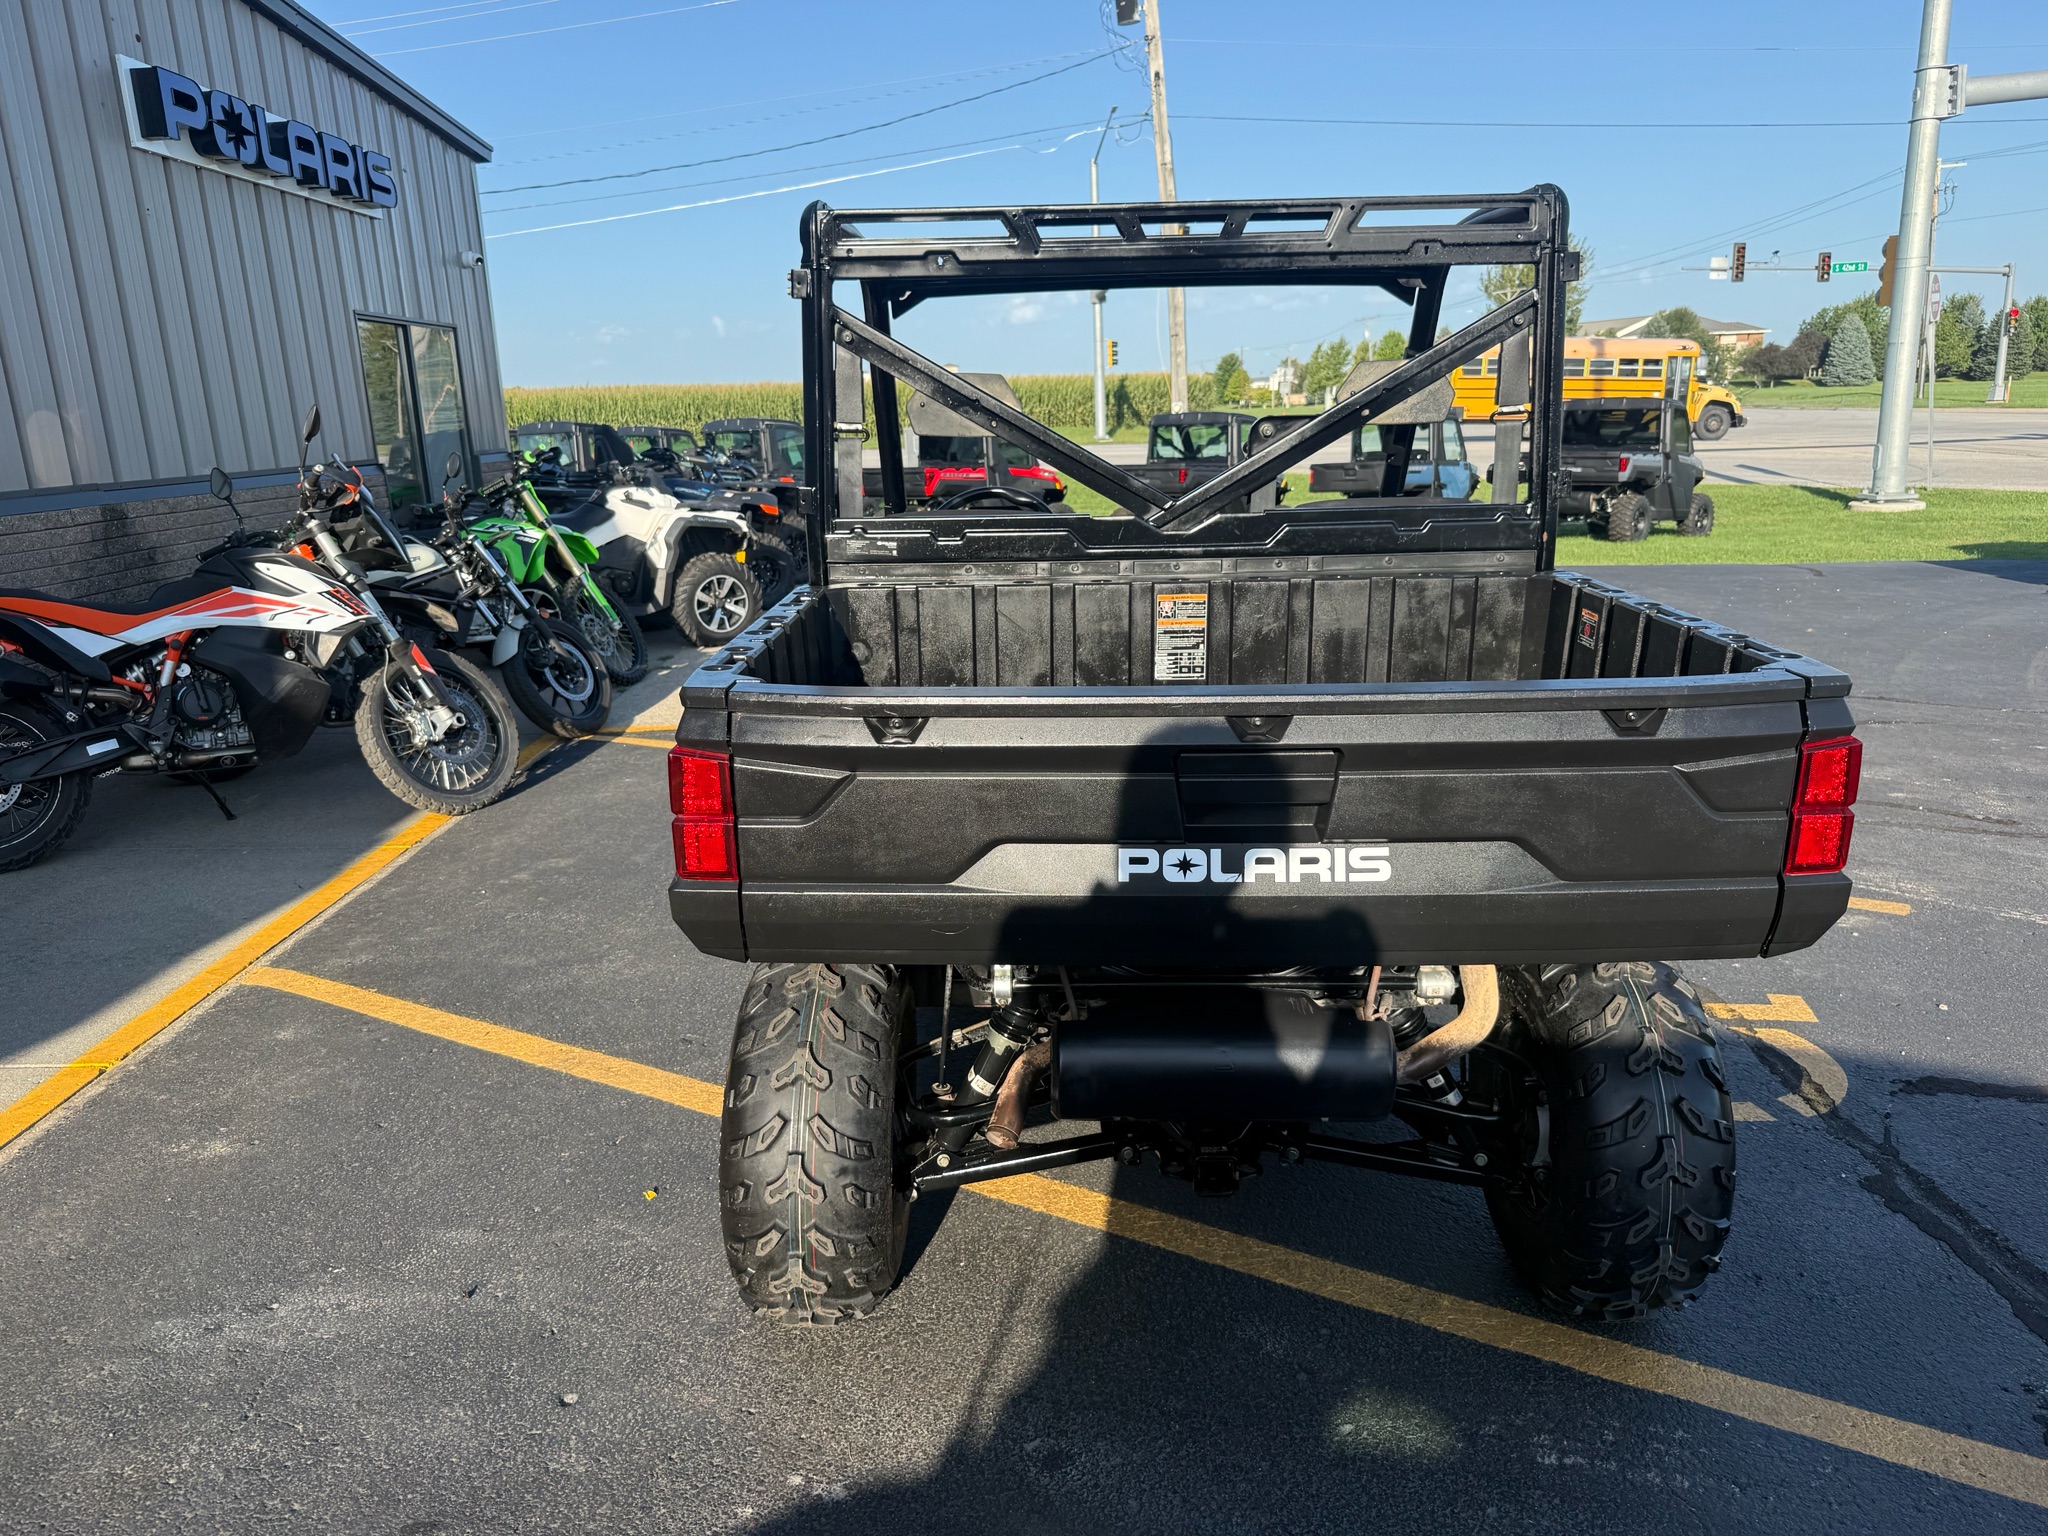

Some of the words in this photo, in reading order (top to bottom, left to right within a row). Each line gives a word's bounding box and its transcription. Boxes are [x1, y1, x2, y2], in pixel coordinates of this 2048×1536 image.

[132, 66, 397, 208] POLARIS
[1835, 264, 1840, 272] S
[1842, 263, 1856, 271] 42nd
[1858, 263, 1865, 271] St
[1117, 846, 1393, 884] POLARIS
